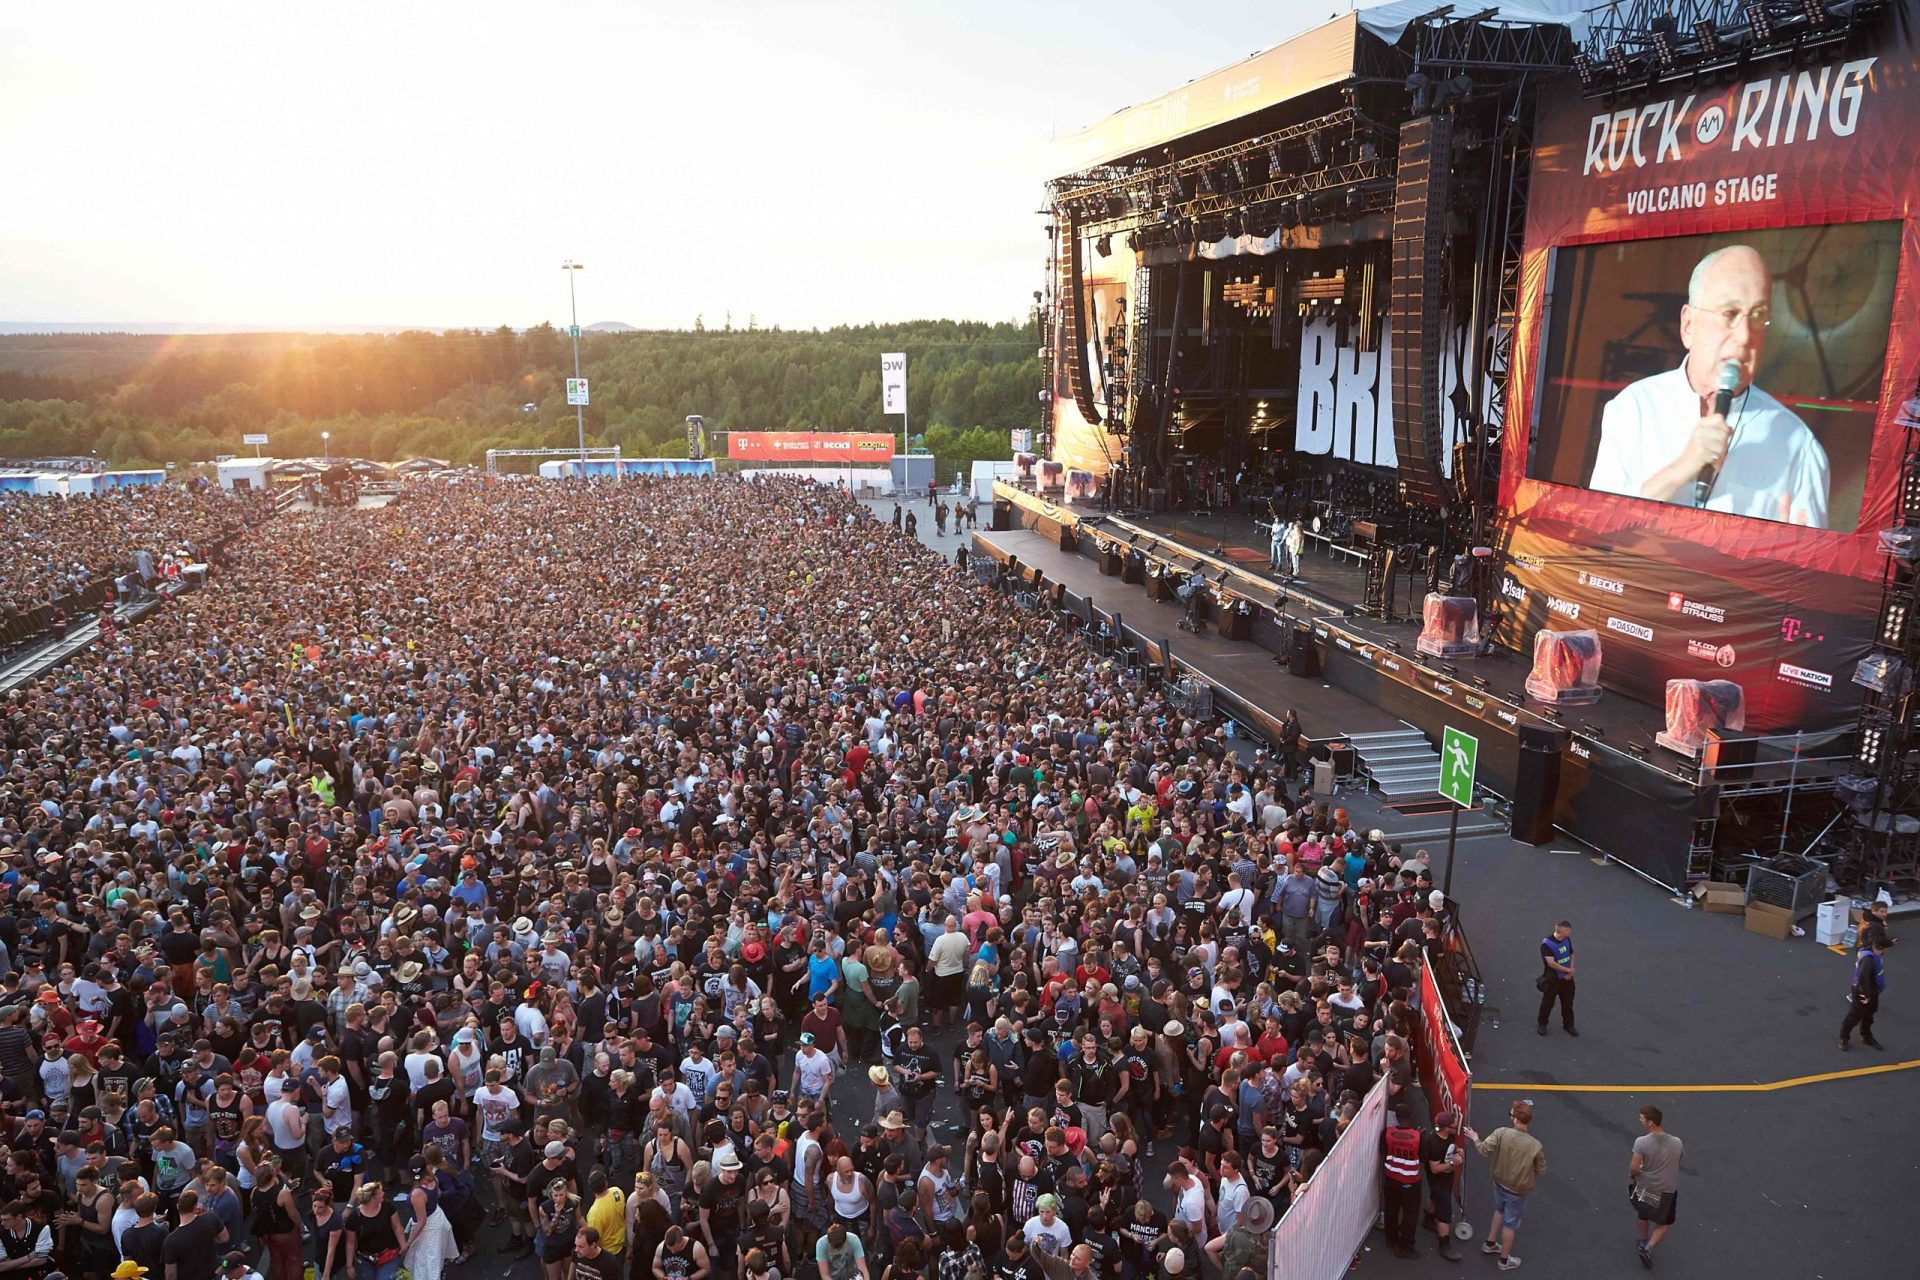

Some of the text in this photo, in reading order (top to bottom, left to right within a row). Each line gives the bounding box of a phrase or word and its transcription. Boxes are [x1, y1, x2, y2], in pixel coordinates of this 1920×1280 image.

[1583, 57, 1878, 176] ROCK AM RING
[1627, 173, 1778, 215] VOLCANO STAGE
[1589, 576, 1624, 593] BECK'S
[1682, 607, 1724, 623] STRAUSS
[1683, 600, 1726, 615] ENGELBERT
[1782, 666, 1829, 683] LIVE NATION
[1130, 1223, 1159, 1235] MANCHE
